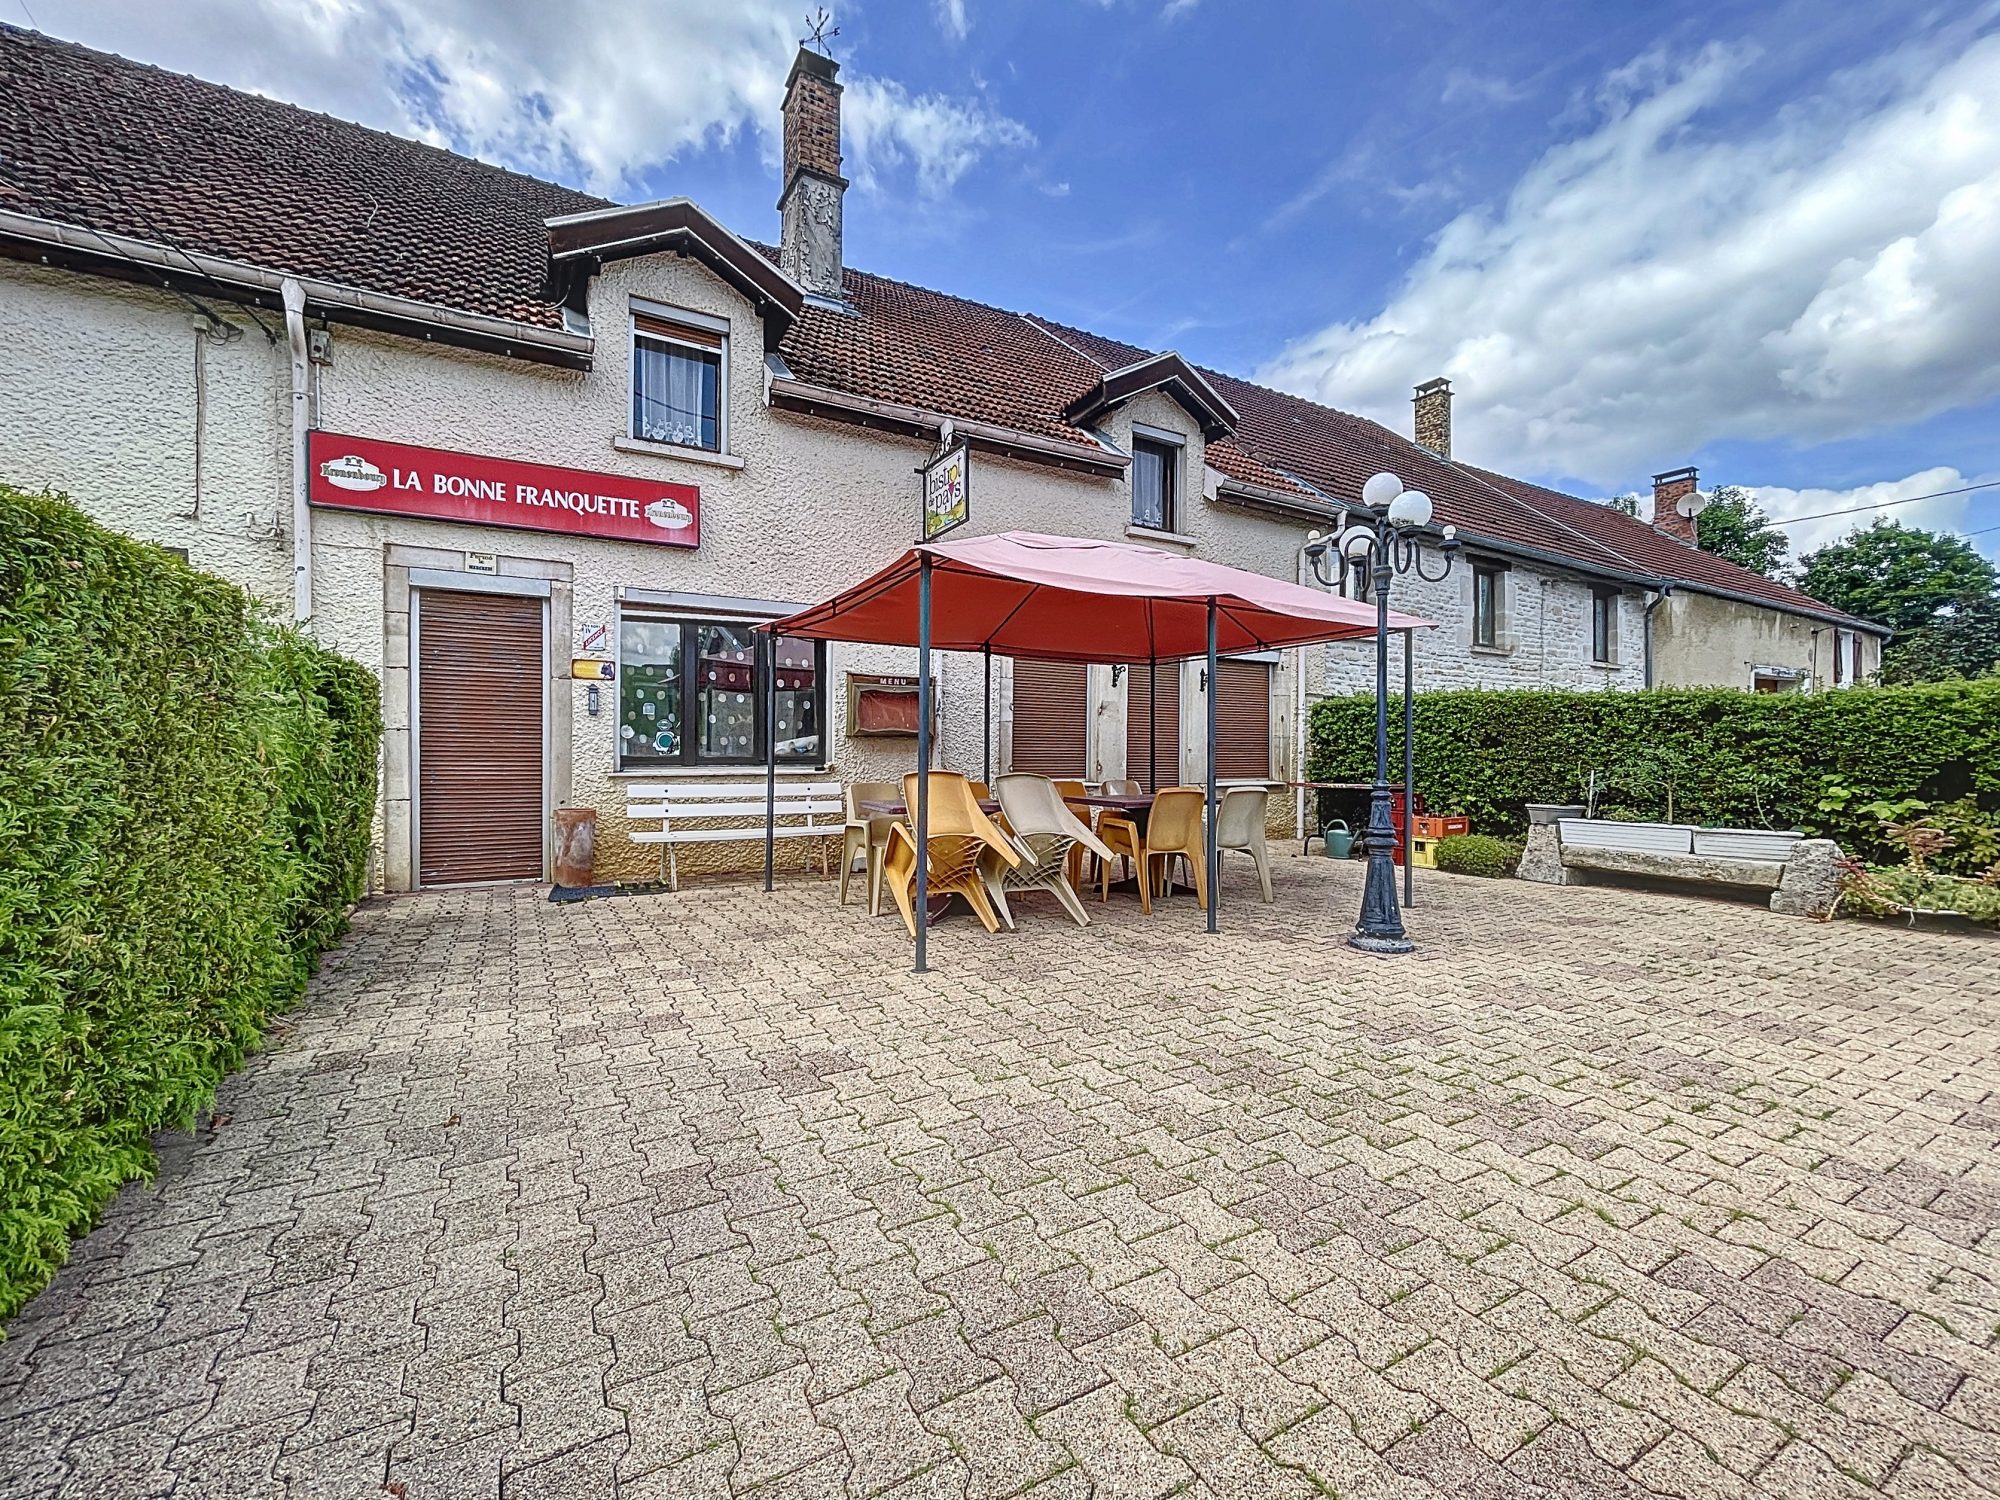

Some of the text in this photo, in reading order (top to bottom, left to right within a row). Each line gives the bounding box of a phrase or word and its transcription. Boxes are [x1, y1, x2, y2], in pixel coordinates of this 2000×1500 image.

[393, 468, 640, 518] LA BONNE FRANQUETTE
[929, 454, 962, 495] bistrot
[880, 677, 907, 685] MENU
